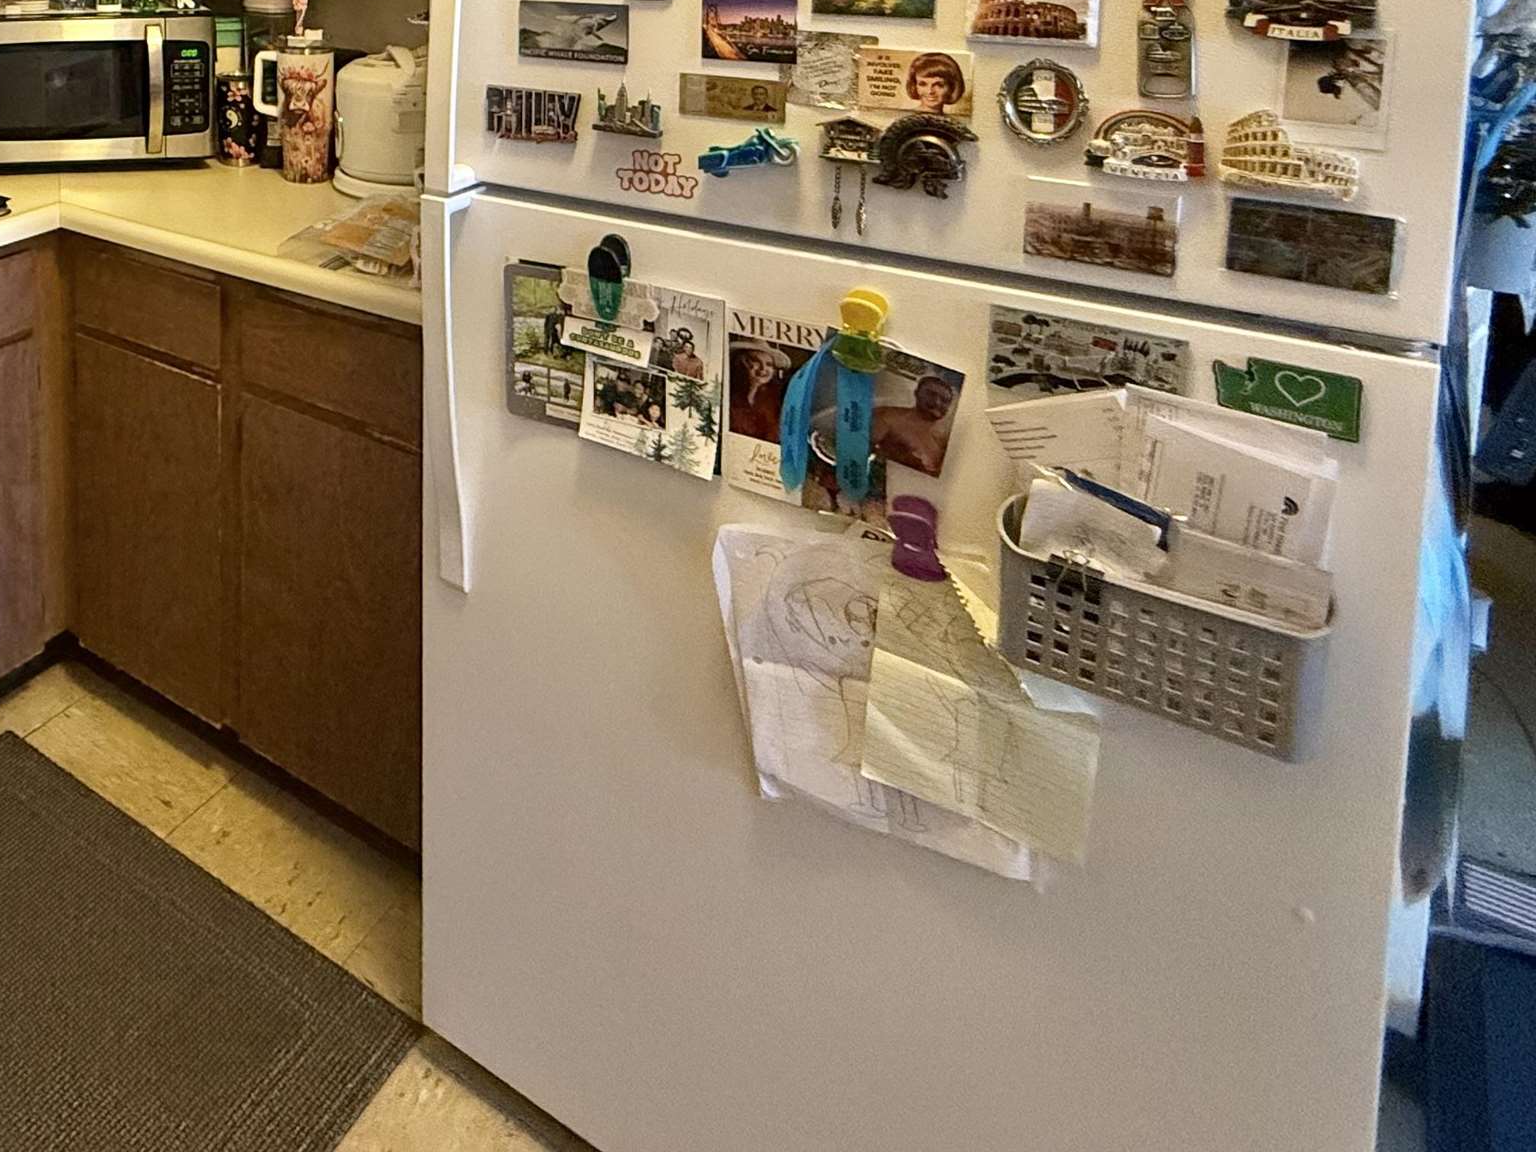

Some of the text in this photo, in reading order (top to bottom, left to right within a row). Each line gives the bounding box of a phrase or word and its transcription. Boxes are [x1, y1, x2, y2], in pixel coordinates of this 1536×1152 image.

[1270, 27, 1321, 39] ITALIA
[520, 49, 625, 62] PACIFIC WHALE FOUNDATION
[873, 68, 894, 76] FAKE
[486, 85, 582, 140] PHILLY
[632, 149, 682, 174] NOT
[1108, 163, 1180, 180] VENEZIA
[616, 168, 698, 199] TODAY
[732, 311, 827, 351] MERRY
[1250, 402, 1344, 432] WASHINGTON
